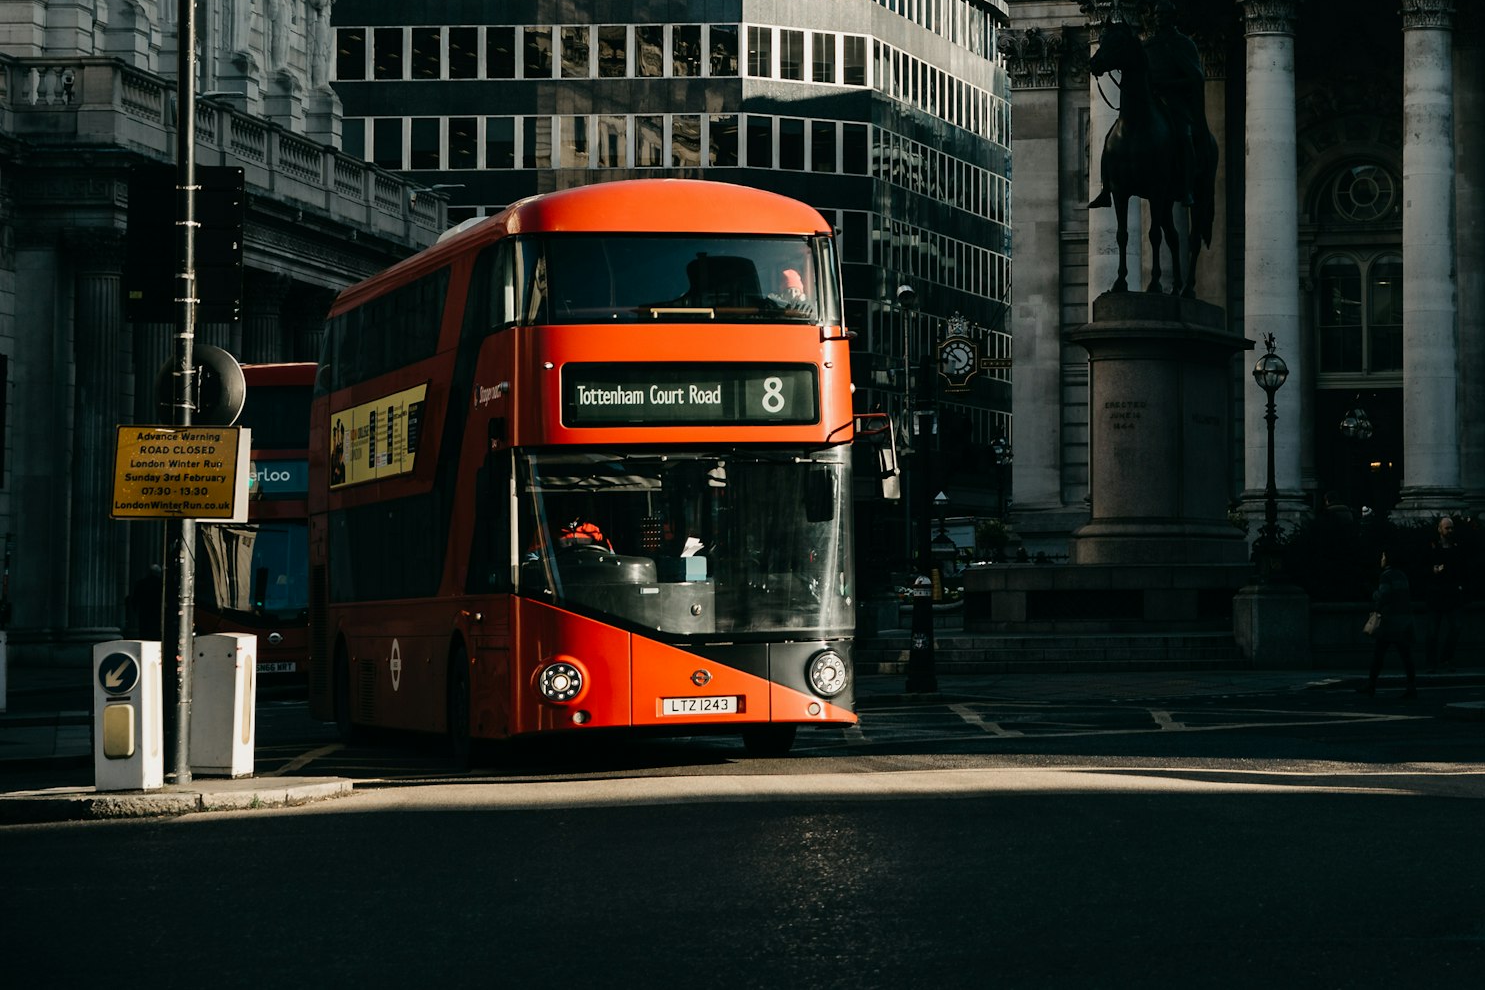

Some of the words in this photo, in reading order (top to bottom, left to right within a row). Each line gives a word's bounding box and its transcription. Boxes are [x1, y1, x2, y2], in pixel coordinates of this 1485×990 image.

[577, 385, 644, 405] Tottenham
[649, 385, 684, 405] Court
[689, 384, 721, 405] Road
[761, 376, 785, 413] 8
[1105, 401, 1146, 409] ERECTED
[137, 432, 178, 441] Advance
[181, 432, 220, 442] Warning
[140, 446, 169, 454] ROAD
[173, 446, 215, 454] CLOSED
[130, 460, 165, 468] London
[168, 460, 200, 468] Winter
[203, 460, 223, 468] Run
[125, 473, 160, 483] Sunday
[163, 473, 181, 482] 3rd
[183, 473, 227, 483] February
[250, 468, 290, 481] erloo
[141, 487, 171, 495] 07:30
[180, 487, 208, 495] 13:30
[115, 501, 230, 510] LondonWinterRun.co.uk
